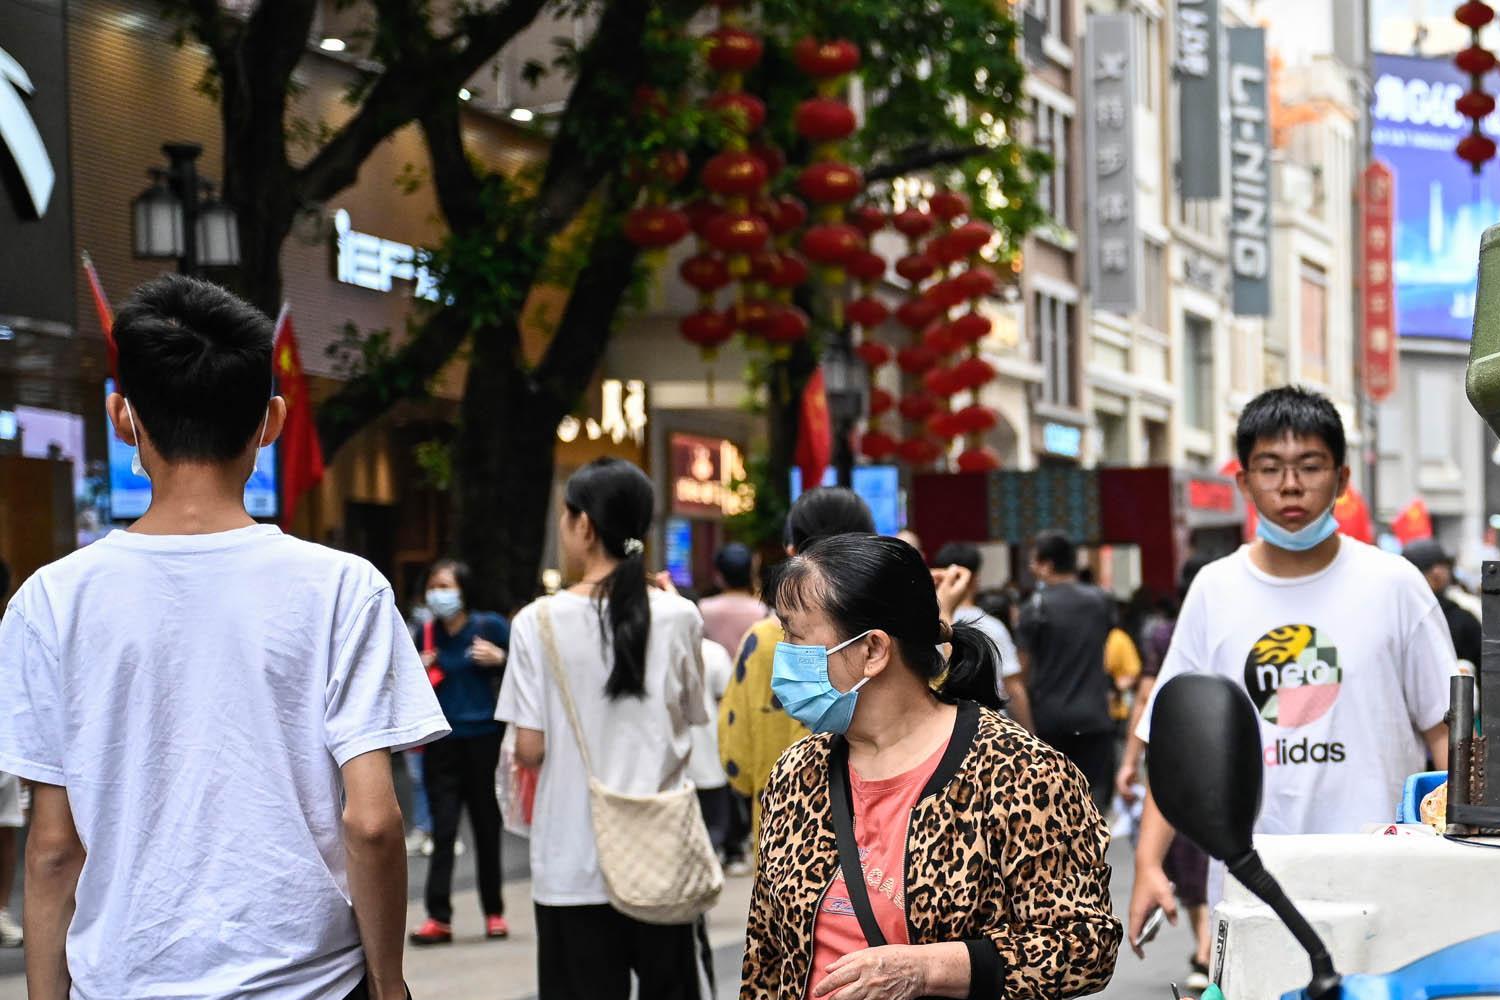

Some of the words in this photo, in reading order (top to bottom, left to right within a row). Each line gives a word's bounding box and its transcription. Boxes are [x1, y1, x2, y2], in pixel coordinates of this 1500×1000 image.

[1231, 63, 1268, 279] LI-NING
[1256, 660, 1331, 692] neo
[1263, 737, 1346, 767] didas
